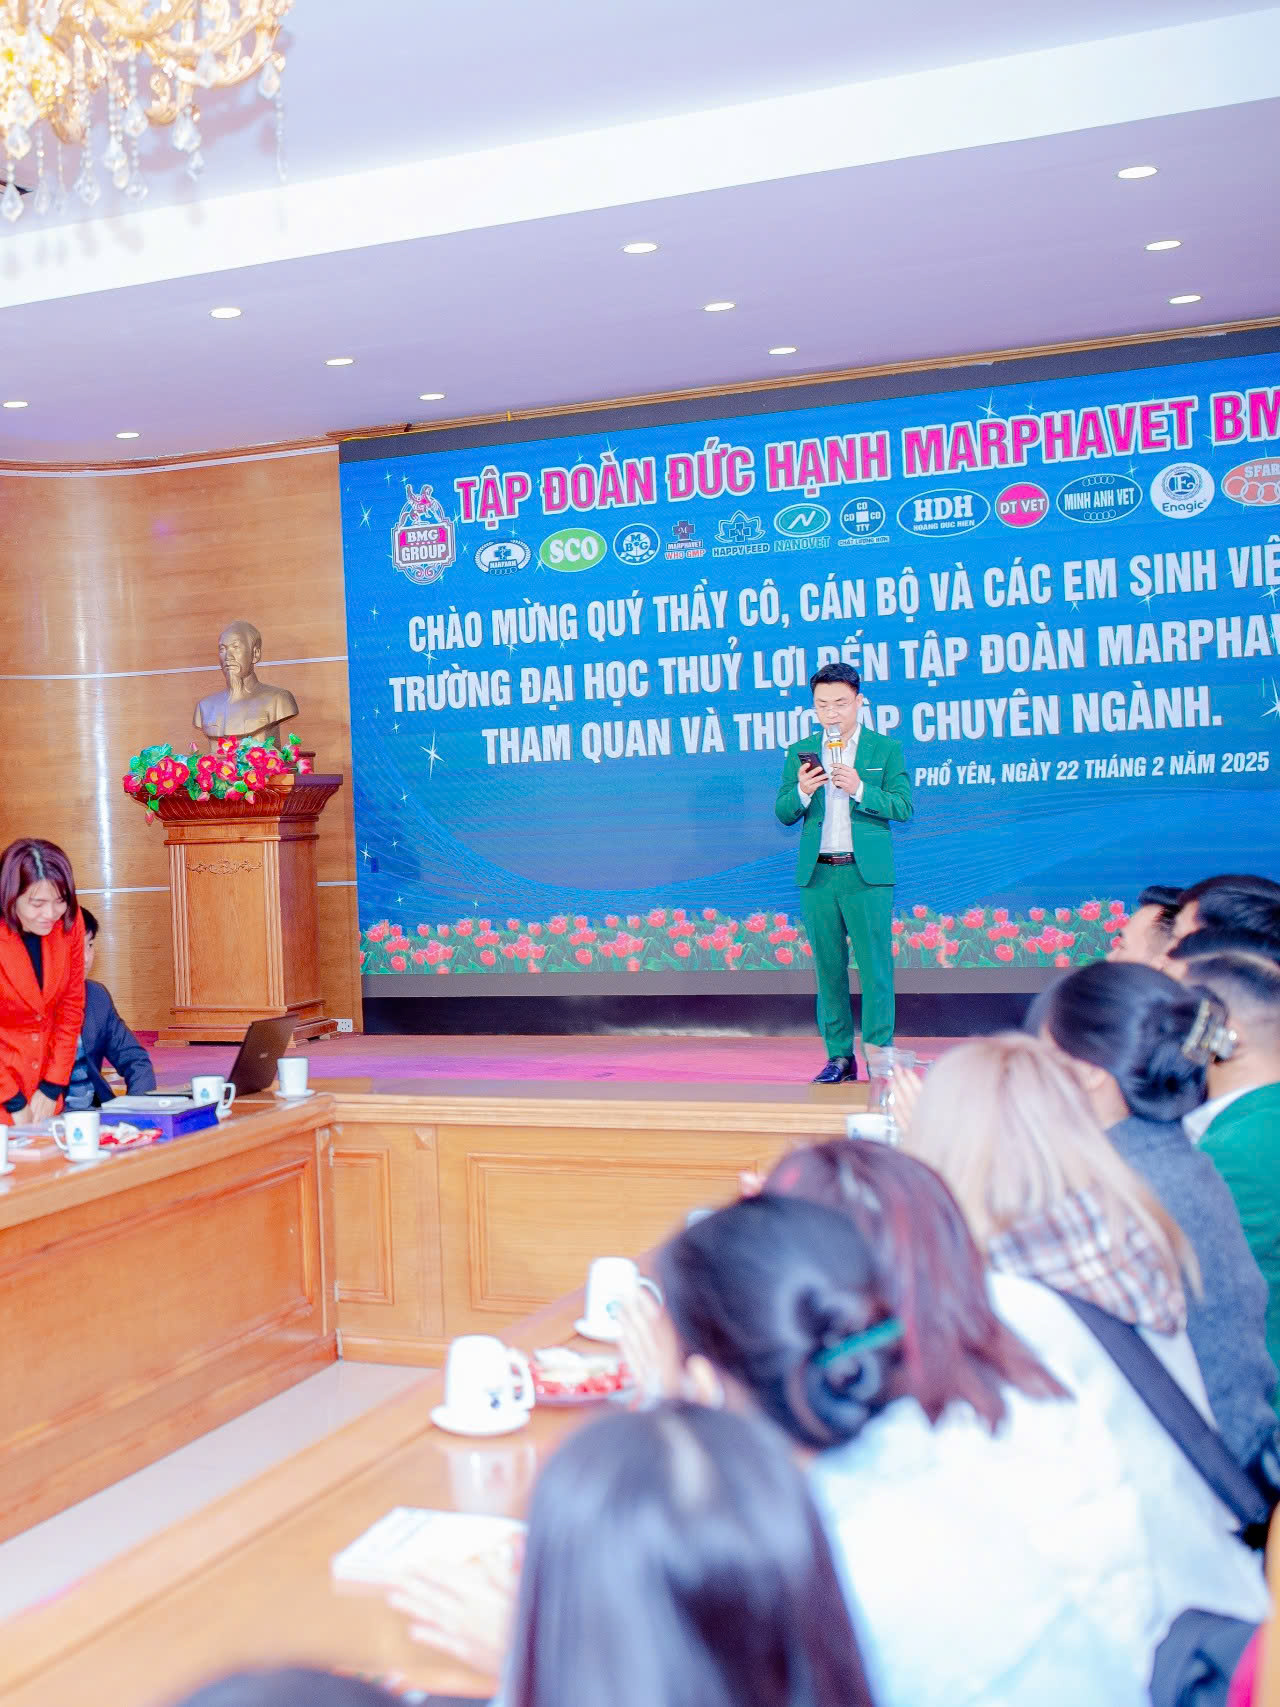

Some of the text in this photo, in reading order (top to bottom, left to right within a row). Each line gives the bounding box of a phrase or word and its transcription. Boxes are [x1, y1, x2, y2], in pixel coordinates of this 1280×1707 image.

[454, 465, 531, 530] TẬP
[540, 451, 656, 514] ĐOÀN
[665, 437, 755, 502] ĐỨC
[766, 431, 891, 498] HẠNH
[902, 396, 1198, 478] MARPHAVET
[1000, 498, 1046, 515] DT VET
[1064, 487, 1135, 511] MINH ANH VET
[1162, 500, 1204, 512] Enagic
[844, 513, 855, 521] CD
[913, 495, 974, 522] HDH
[856, 523, 870, 532] TTY
[913, 523, 938, 531] HOANG
[940, 521, 956, 529] DUC
[406, 529, 439, 542] BMG
[775, 537, 830, 551] NANOVET
[401, 543, 447, 561] GROUP
[549, 536, 598, 563] SCO
[713, 543, 769, 557] HAPPY FEED
[409, 606, 482, 652] CHÀO
[492, 598, 577, 646] MỪNG
[588, 590, 644, 642] QUÝ
[653, 579, 728, 632] THẦY
[739, 579, 790, 628] CÔ,
[800, 573, 866, 622] CÁN
[877, 567, 919, 622] BỘ
[930, 562, 974, 611] VÀ
[985, 557, 1051, 607] CÁC
[1064, 558, 1117, 601] EM
[1130, 549, 1217, 597] SINH
[389, 664, 511, 713] TRƯỜNG
[520, 665, 574, 711] ĐẠI
[584, 660, 649, 707] HỌC
[659, 636, 742, 694] THUỶ
[754, 645, 806, 697] LỢI
[899, 630, 968, 687] TẬP
[980, 622, 1085, 675] ĐOÀN
[482, 725, 571, 765] THAM
[582, 719, 671, 763] QUAN
[681, 707, 725, 753] VÀ
[912, 688, 1060, 742] CHUYÊN
[1073, 681, 1223, 734] NGÀNH.
[914, 750, 1270, 787] PHỔ YÊN, NGÀY 22 THÁNG 2 NĂM 2025
